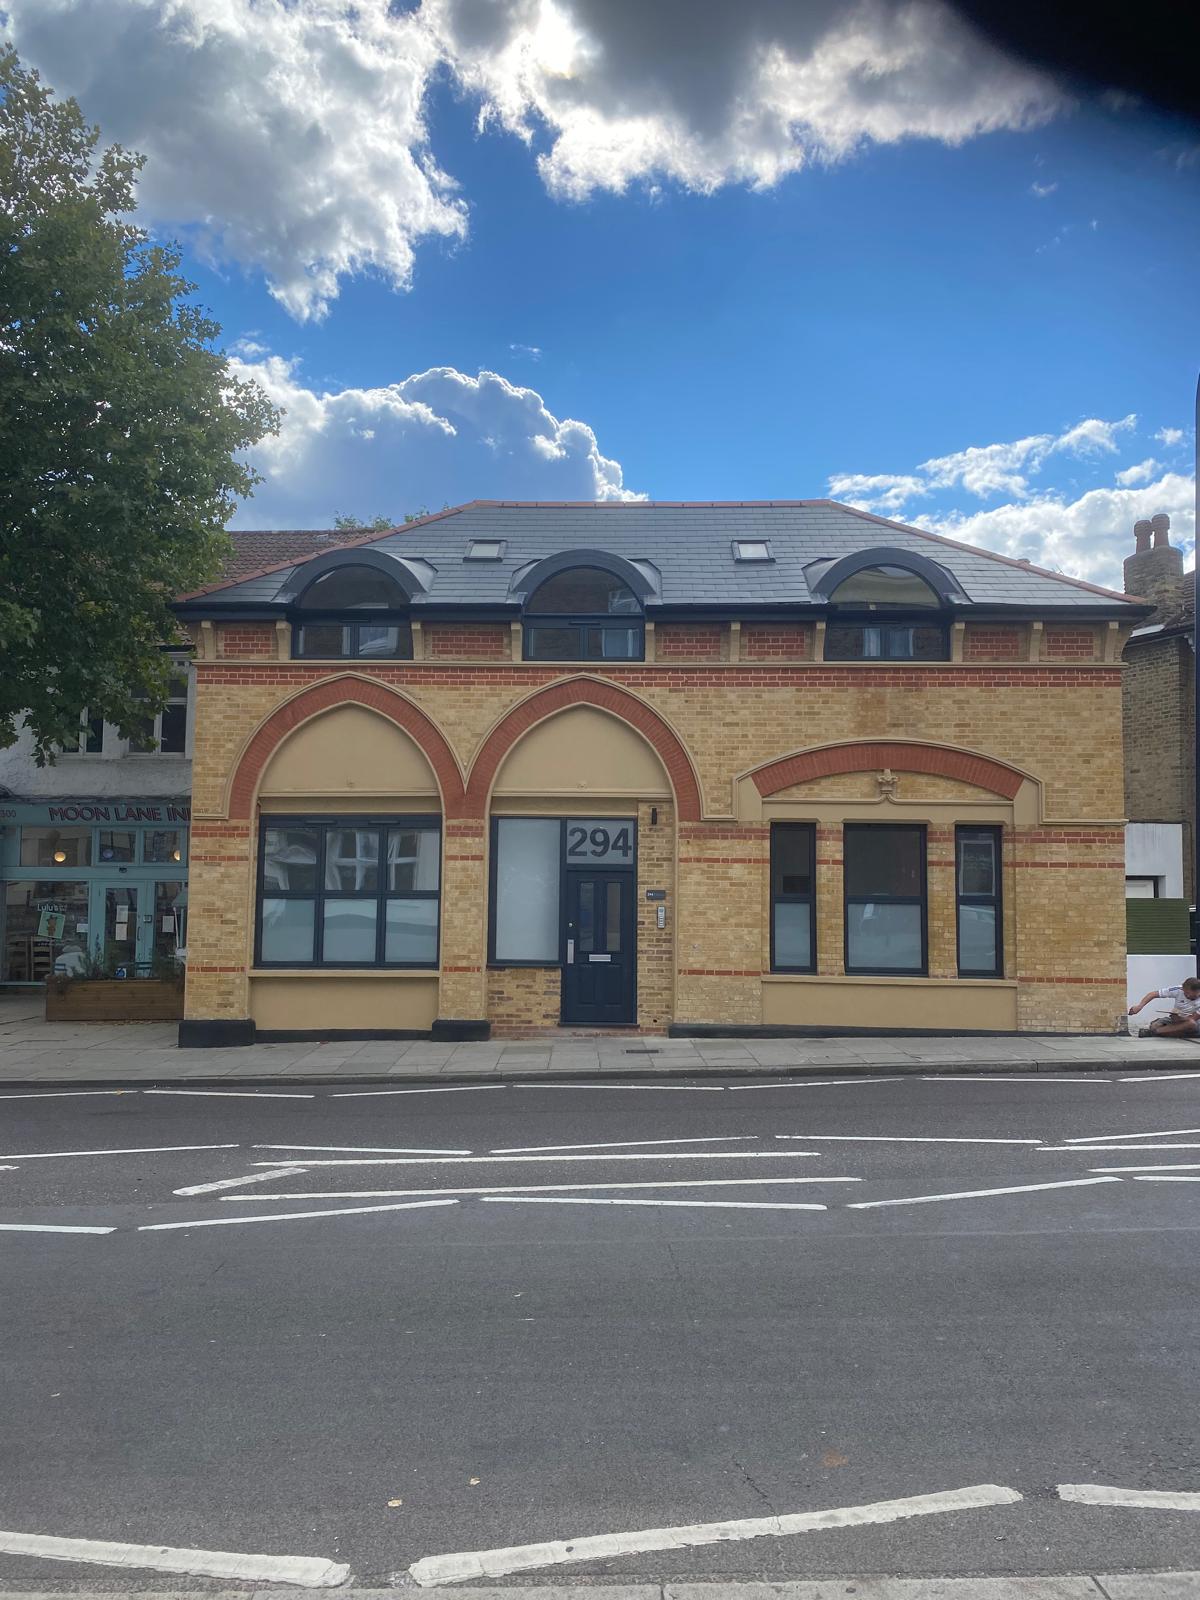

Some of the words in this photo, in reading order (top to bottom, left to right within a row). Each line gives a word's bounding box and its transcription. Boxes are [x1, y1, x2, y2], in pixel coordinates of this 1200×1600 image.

[48, 807, 110, 821] MOON
[114, 807, 162, 821] LANE
[568, 826, 632, 857] 294
